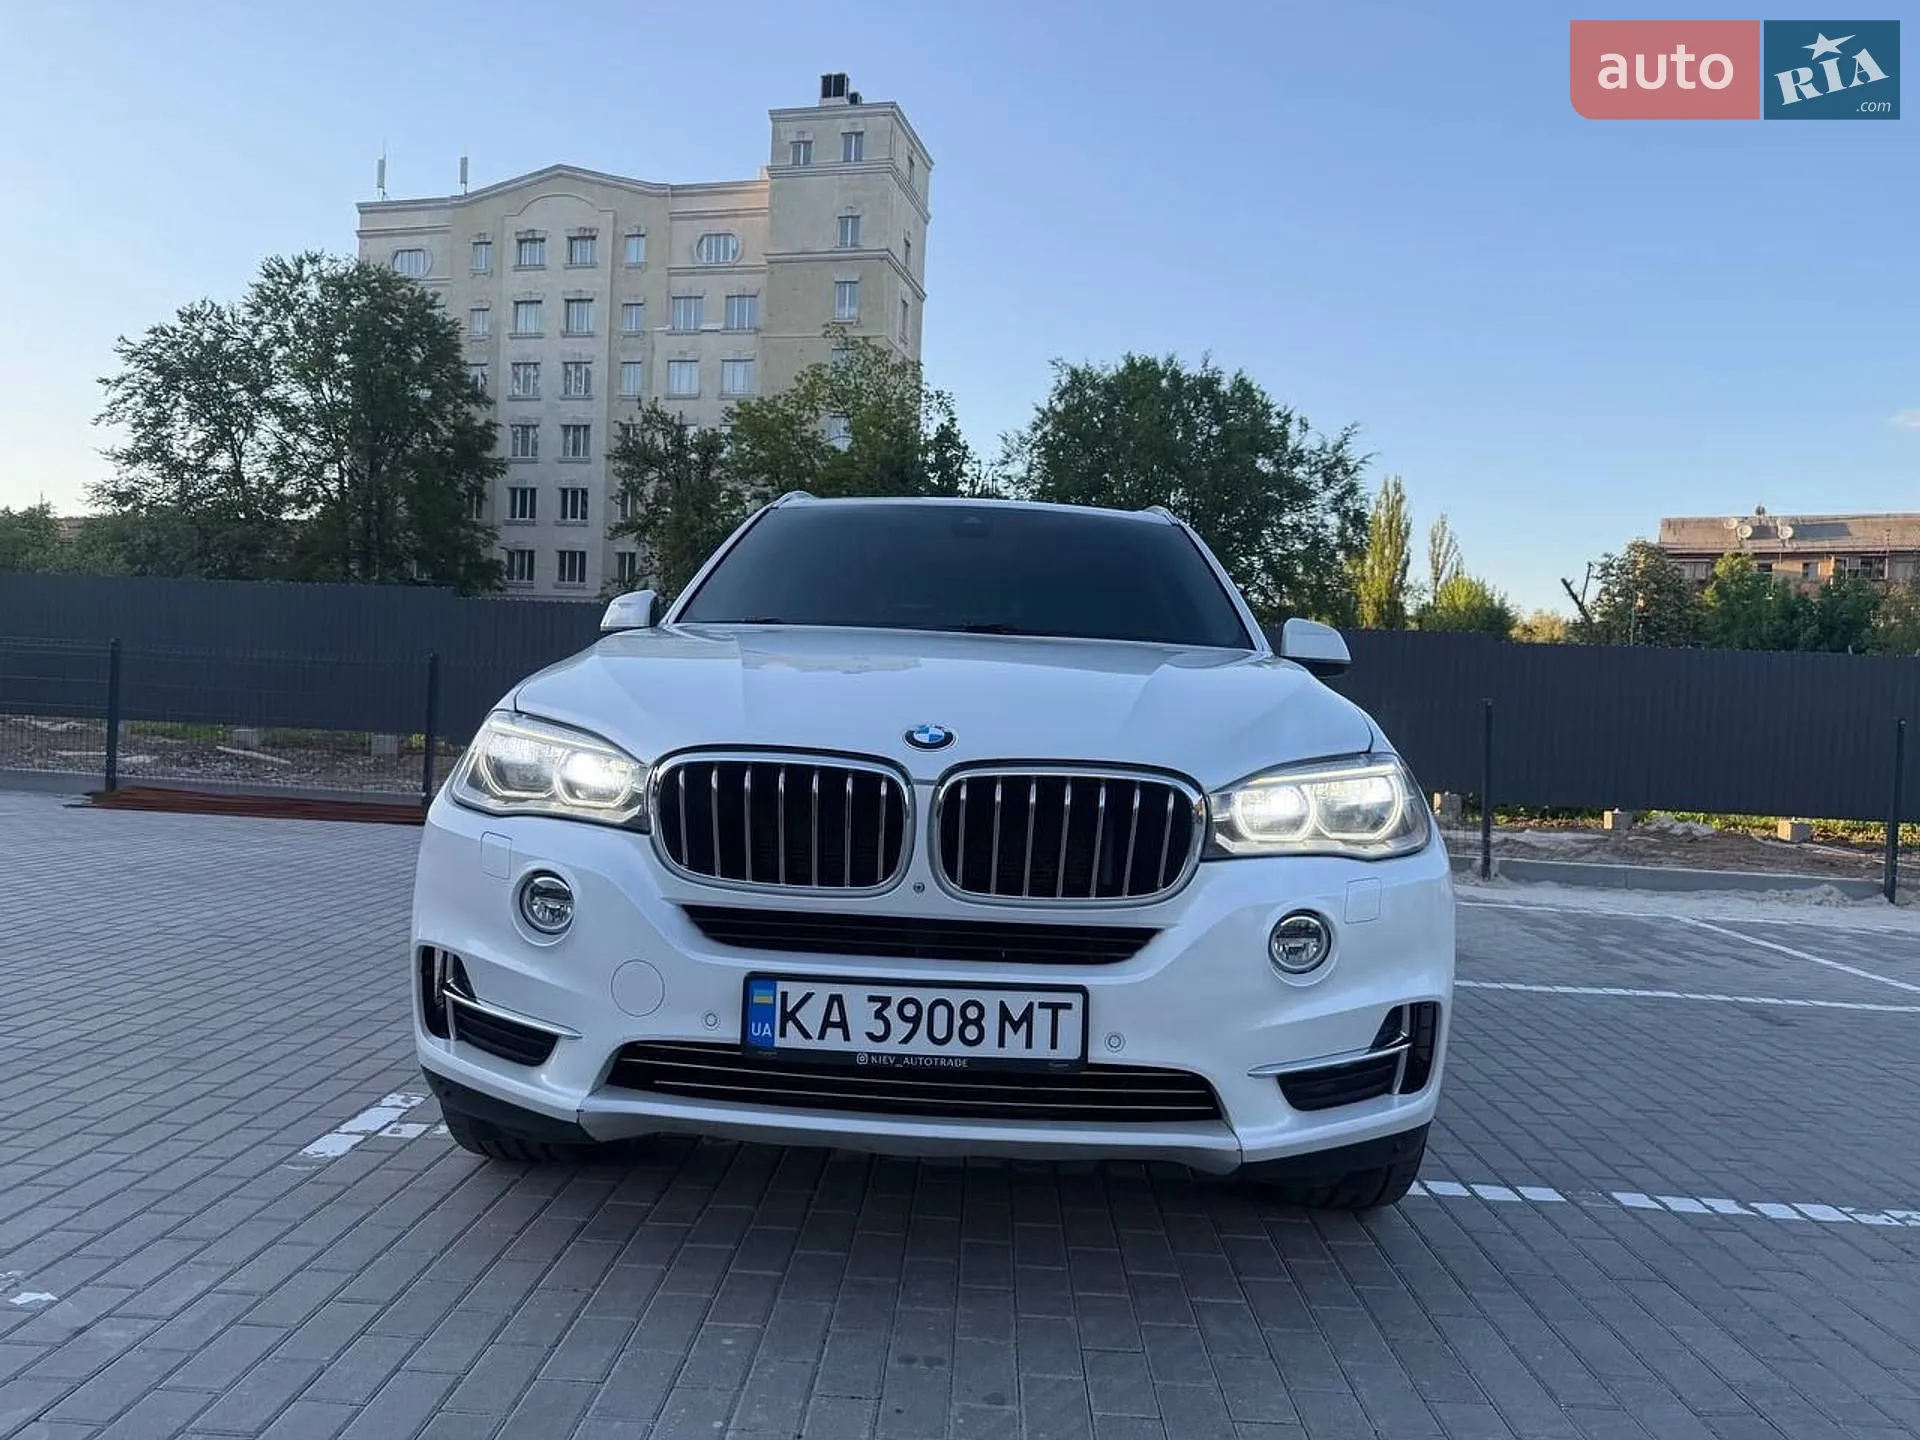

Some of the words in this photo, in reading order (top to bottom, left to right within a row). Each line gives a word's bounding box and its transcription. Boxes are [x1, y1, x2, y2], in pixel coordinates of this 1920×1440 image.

[751, 1021, 772, 1038] UA
[779, 991, 851, 1042] KA
[864, 995, 986, 1047] 3908
[998, 1000, 1073, 1050] MT
